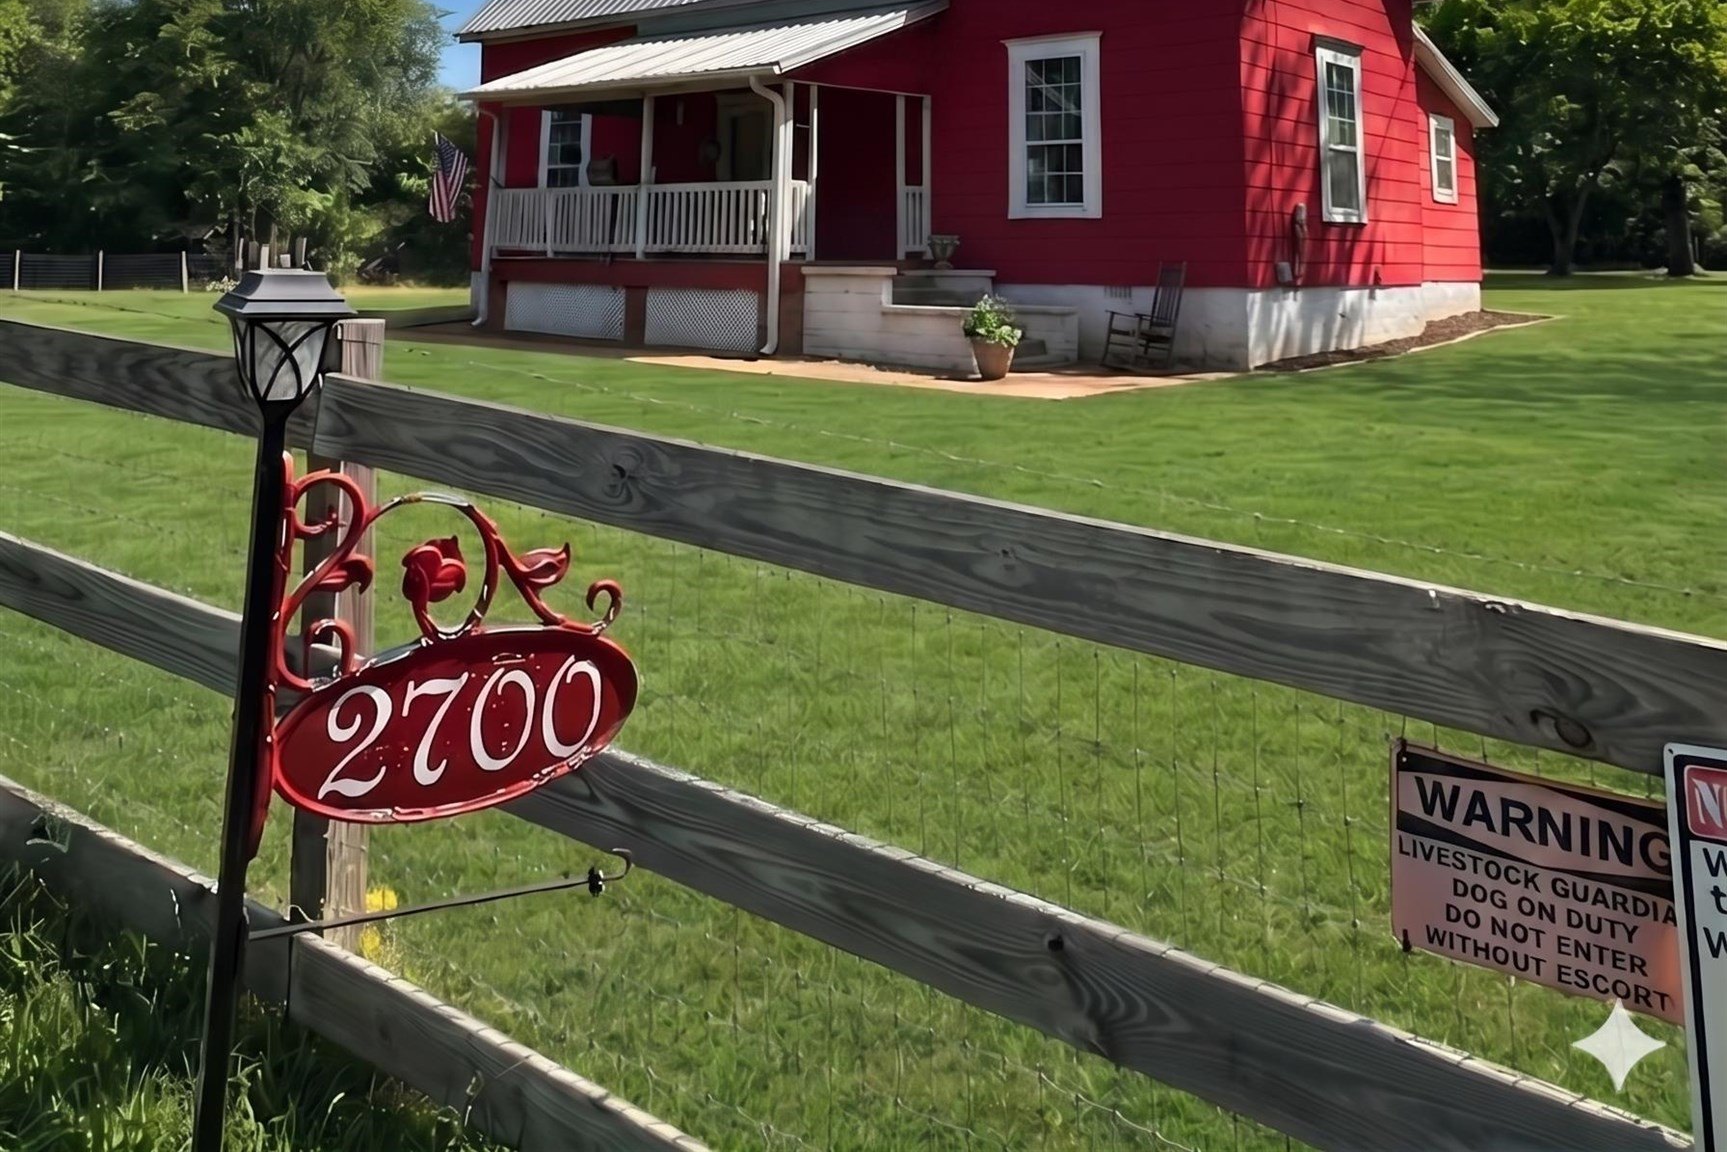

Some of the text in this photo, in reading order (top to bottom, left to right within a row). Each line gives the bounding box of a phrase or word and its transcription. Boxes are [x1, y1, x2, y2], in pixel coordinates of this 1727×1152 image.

[318, 654, 602, 800] 2700
[1399, 835, 1540, 893] LIVESTOCK
[1414, 776, 1673, 876] WARNING
[1445, 903, 1649, 978] DO NOT ENTER
[1453, 878, 1639, 944] DOG ON DUTY
[1426, 925, 1671, 1012] WITHOUT ESCORT
